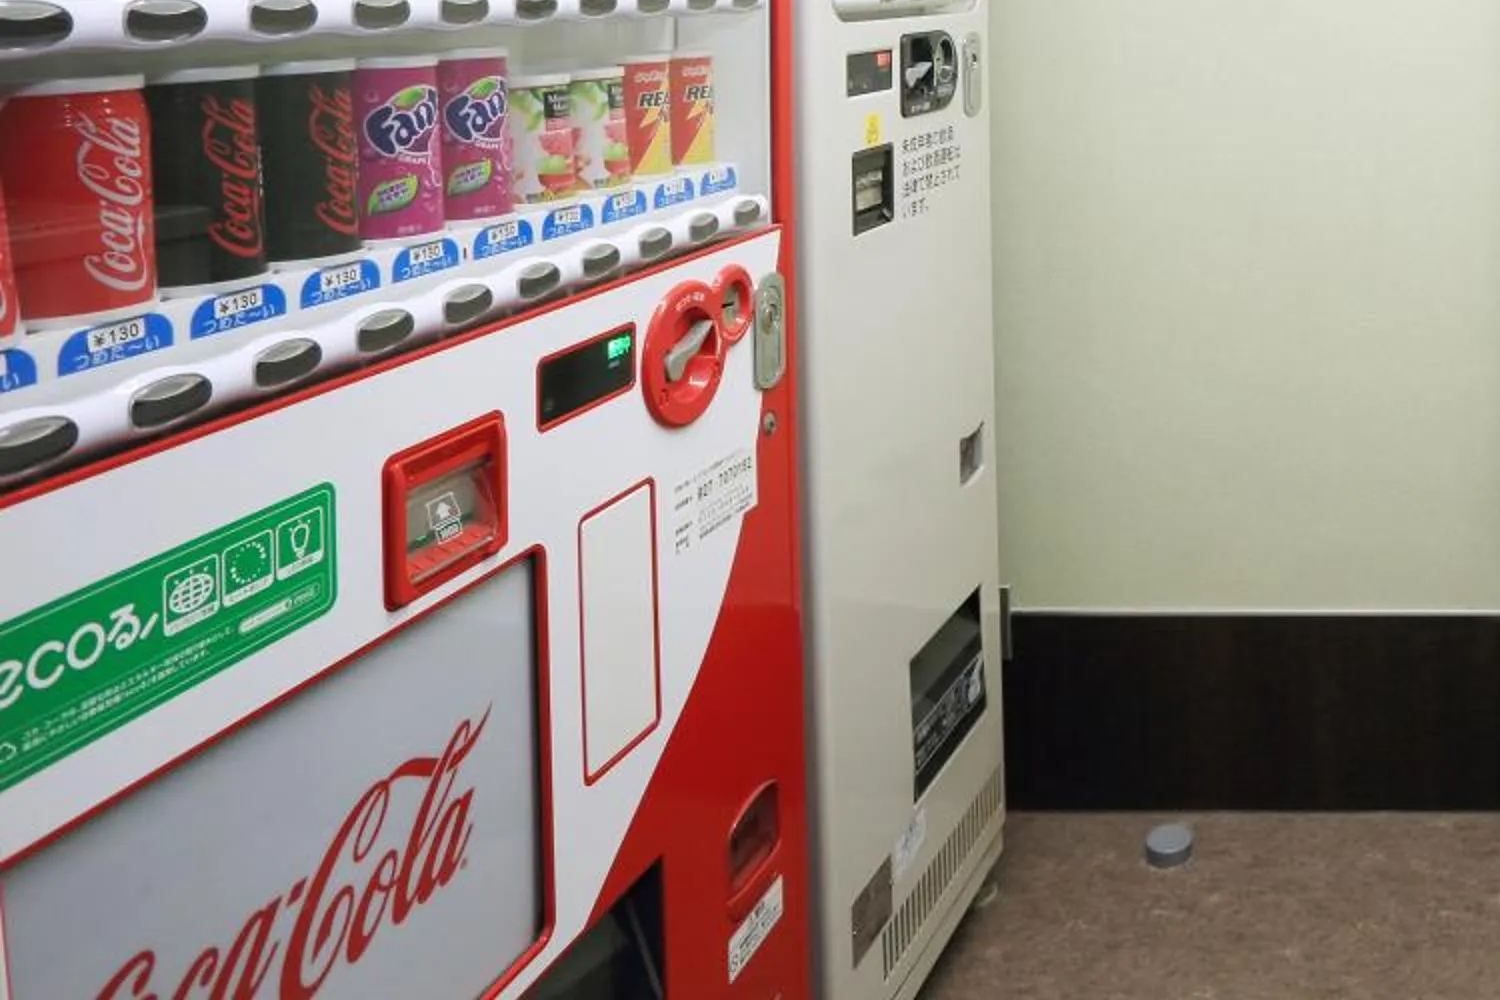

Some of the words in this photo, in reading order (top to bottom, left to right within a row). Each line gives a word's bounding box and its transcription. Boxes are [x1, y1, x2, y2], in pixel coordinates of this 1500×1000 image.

[76, 112, 147, 292] Coca-Cola
[324, 268, 357, 287] ¥130
[218, 292, 258, 313] ¥130
[93, 322, 139, 347] ¥130
